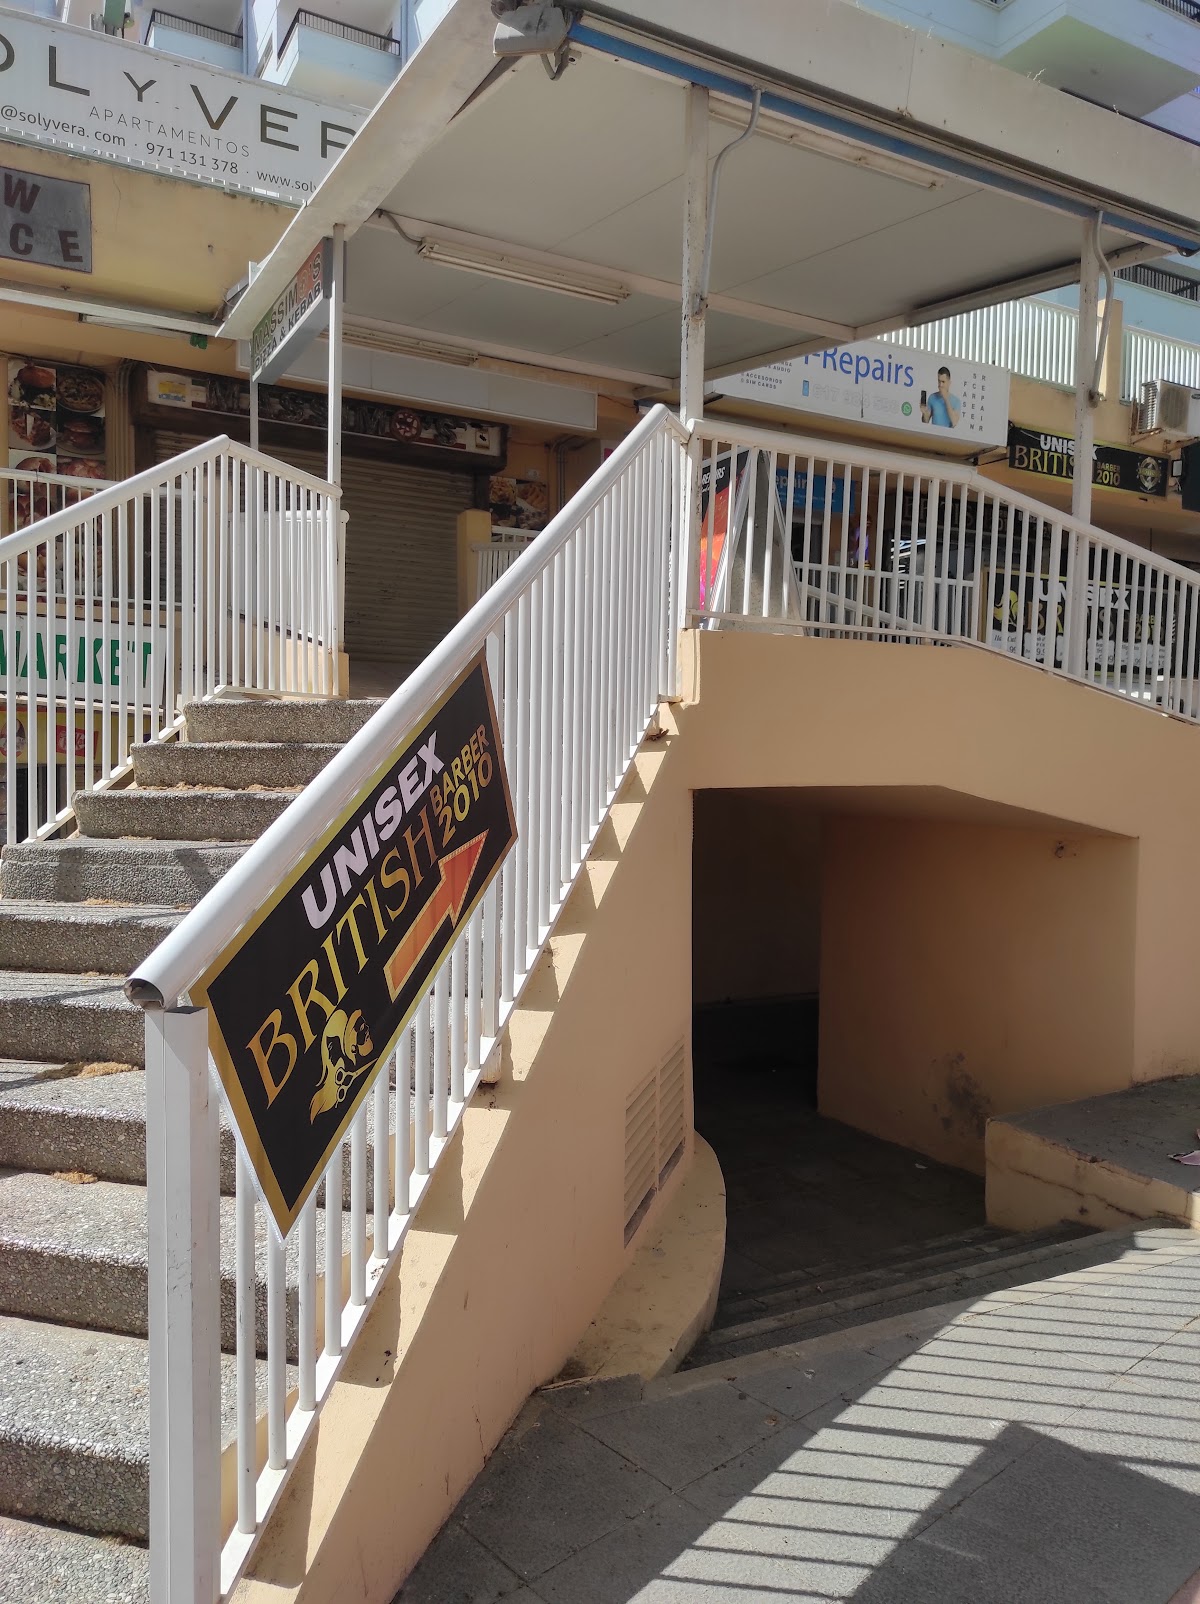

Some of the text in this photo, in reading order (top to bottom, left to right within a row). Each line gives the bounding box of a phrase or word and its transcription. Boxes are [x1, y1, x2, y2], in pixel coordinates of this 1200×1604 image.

[89, 105, 250, 158] APARTAMENTOS
[146, 142, 174, 160] 971
[180, 150, 206, 167] 131
[211, 157, 239, 175] 378
[1096, 469, 1121, 486] 2010
[431, 723, 489, 817] BARBER
[438, 755, 494, 849] 2010
[301, 731, 446, 930] UNISEX
[245, 805, 440, 1110] BRITISH
